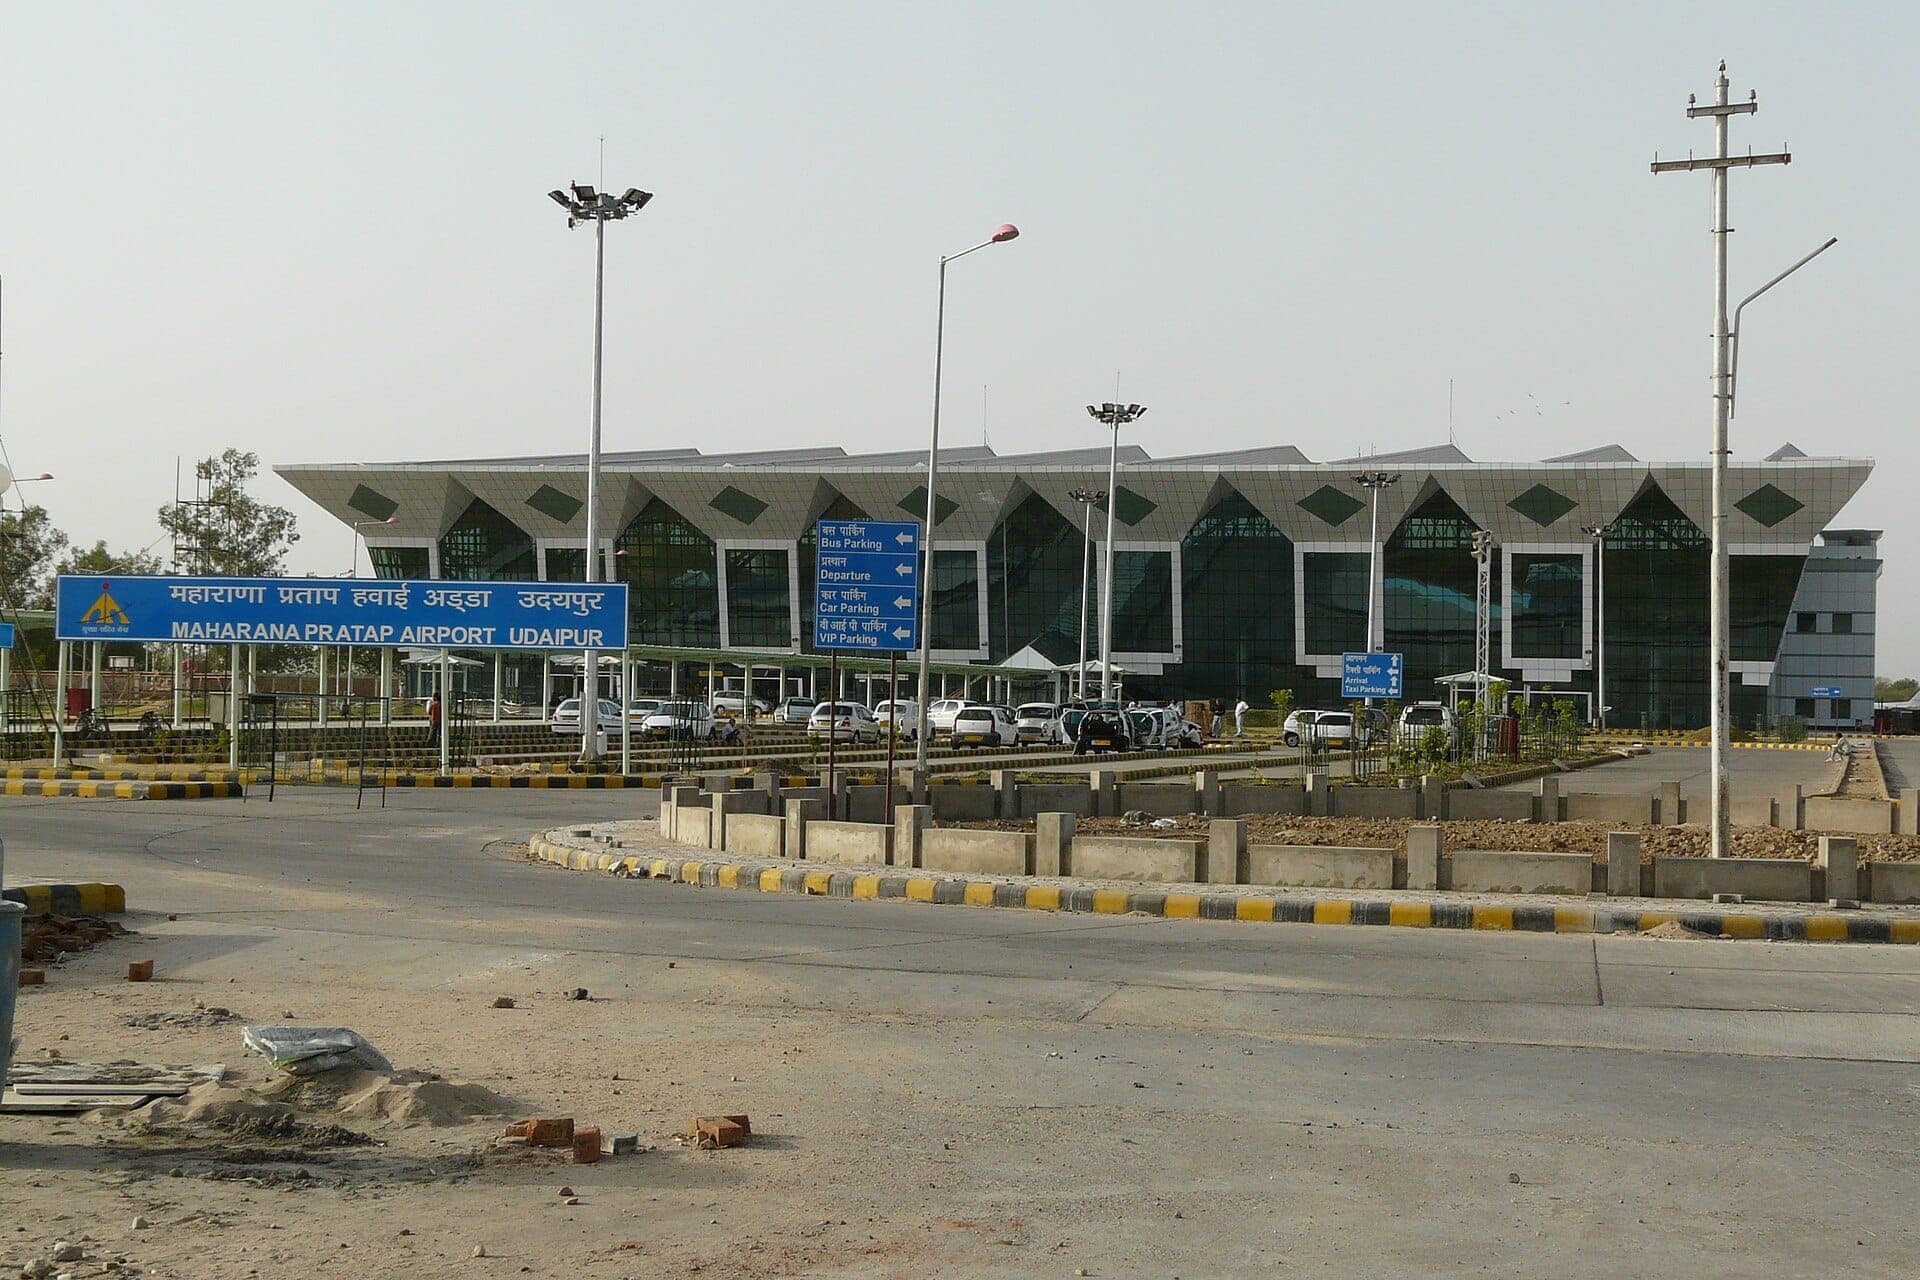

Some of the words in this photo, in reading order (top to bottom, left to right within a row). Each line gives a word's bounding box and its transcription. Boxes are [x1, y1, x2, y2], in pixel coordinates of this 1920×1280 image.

[822, 525, 836, 536] बस
[840, 523, 866, 537] पार्किंग
[821, 538, 841, 548] Bus
[844, 539, 882, 551] Parking
[821, 556, 847, 567] प्रस्थान
[820, 569, 871, 582] Departure
[168, 585, 267, 604] महाराणा
[277, 586, 341, 605] प्रताप
[351, 583, 410, 610] हवाई
[423, 590, 492, 612] अड्डा
[518, 591, 605, 617] उदयपुर
[820, 589, 837, 600] कार
[841, 588, 867, 601] पार्किंग
[820, 602, 838, 612] Car
[840, 603, 879, 615] Parking
[861, 618, 887, 632] पार्किंग
[171, 621, 299, 641] MAHARANA
[304, 623, 394, 643] PRATAP
[400, 626, 496, 645] AIRPORT
[509, 628, 604, 647] UDAIPUR
[819, 633, 837, 642] VIP
[839, 634, 877, 646] Parking
[1345, 685, 1359, 693] Taxi
[1360, 685, 1386, 695] Parking
